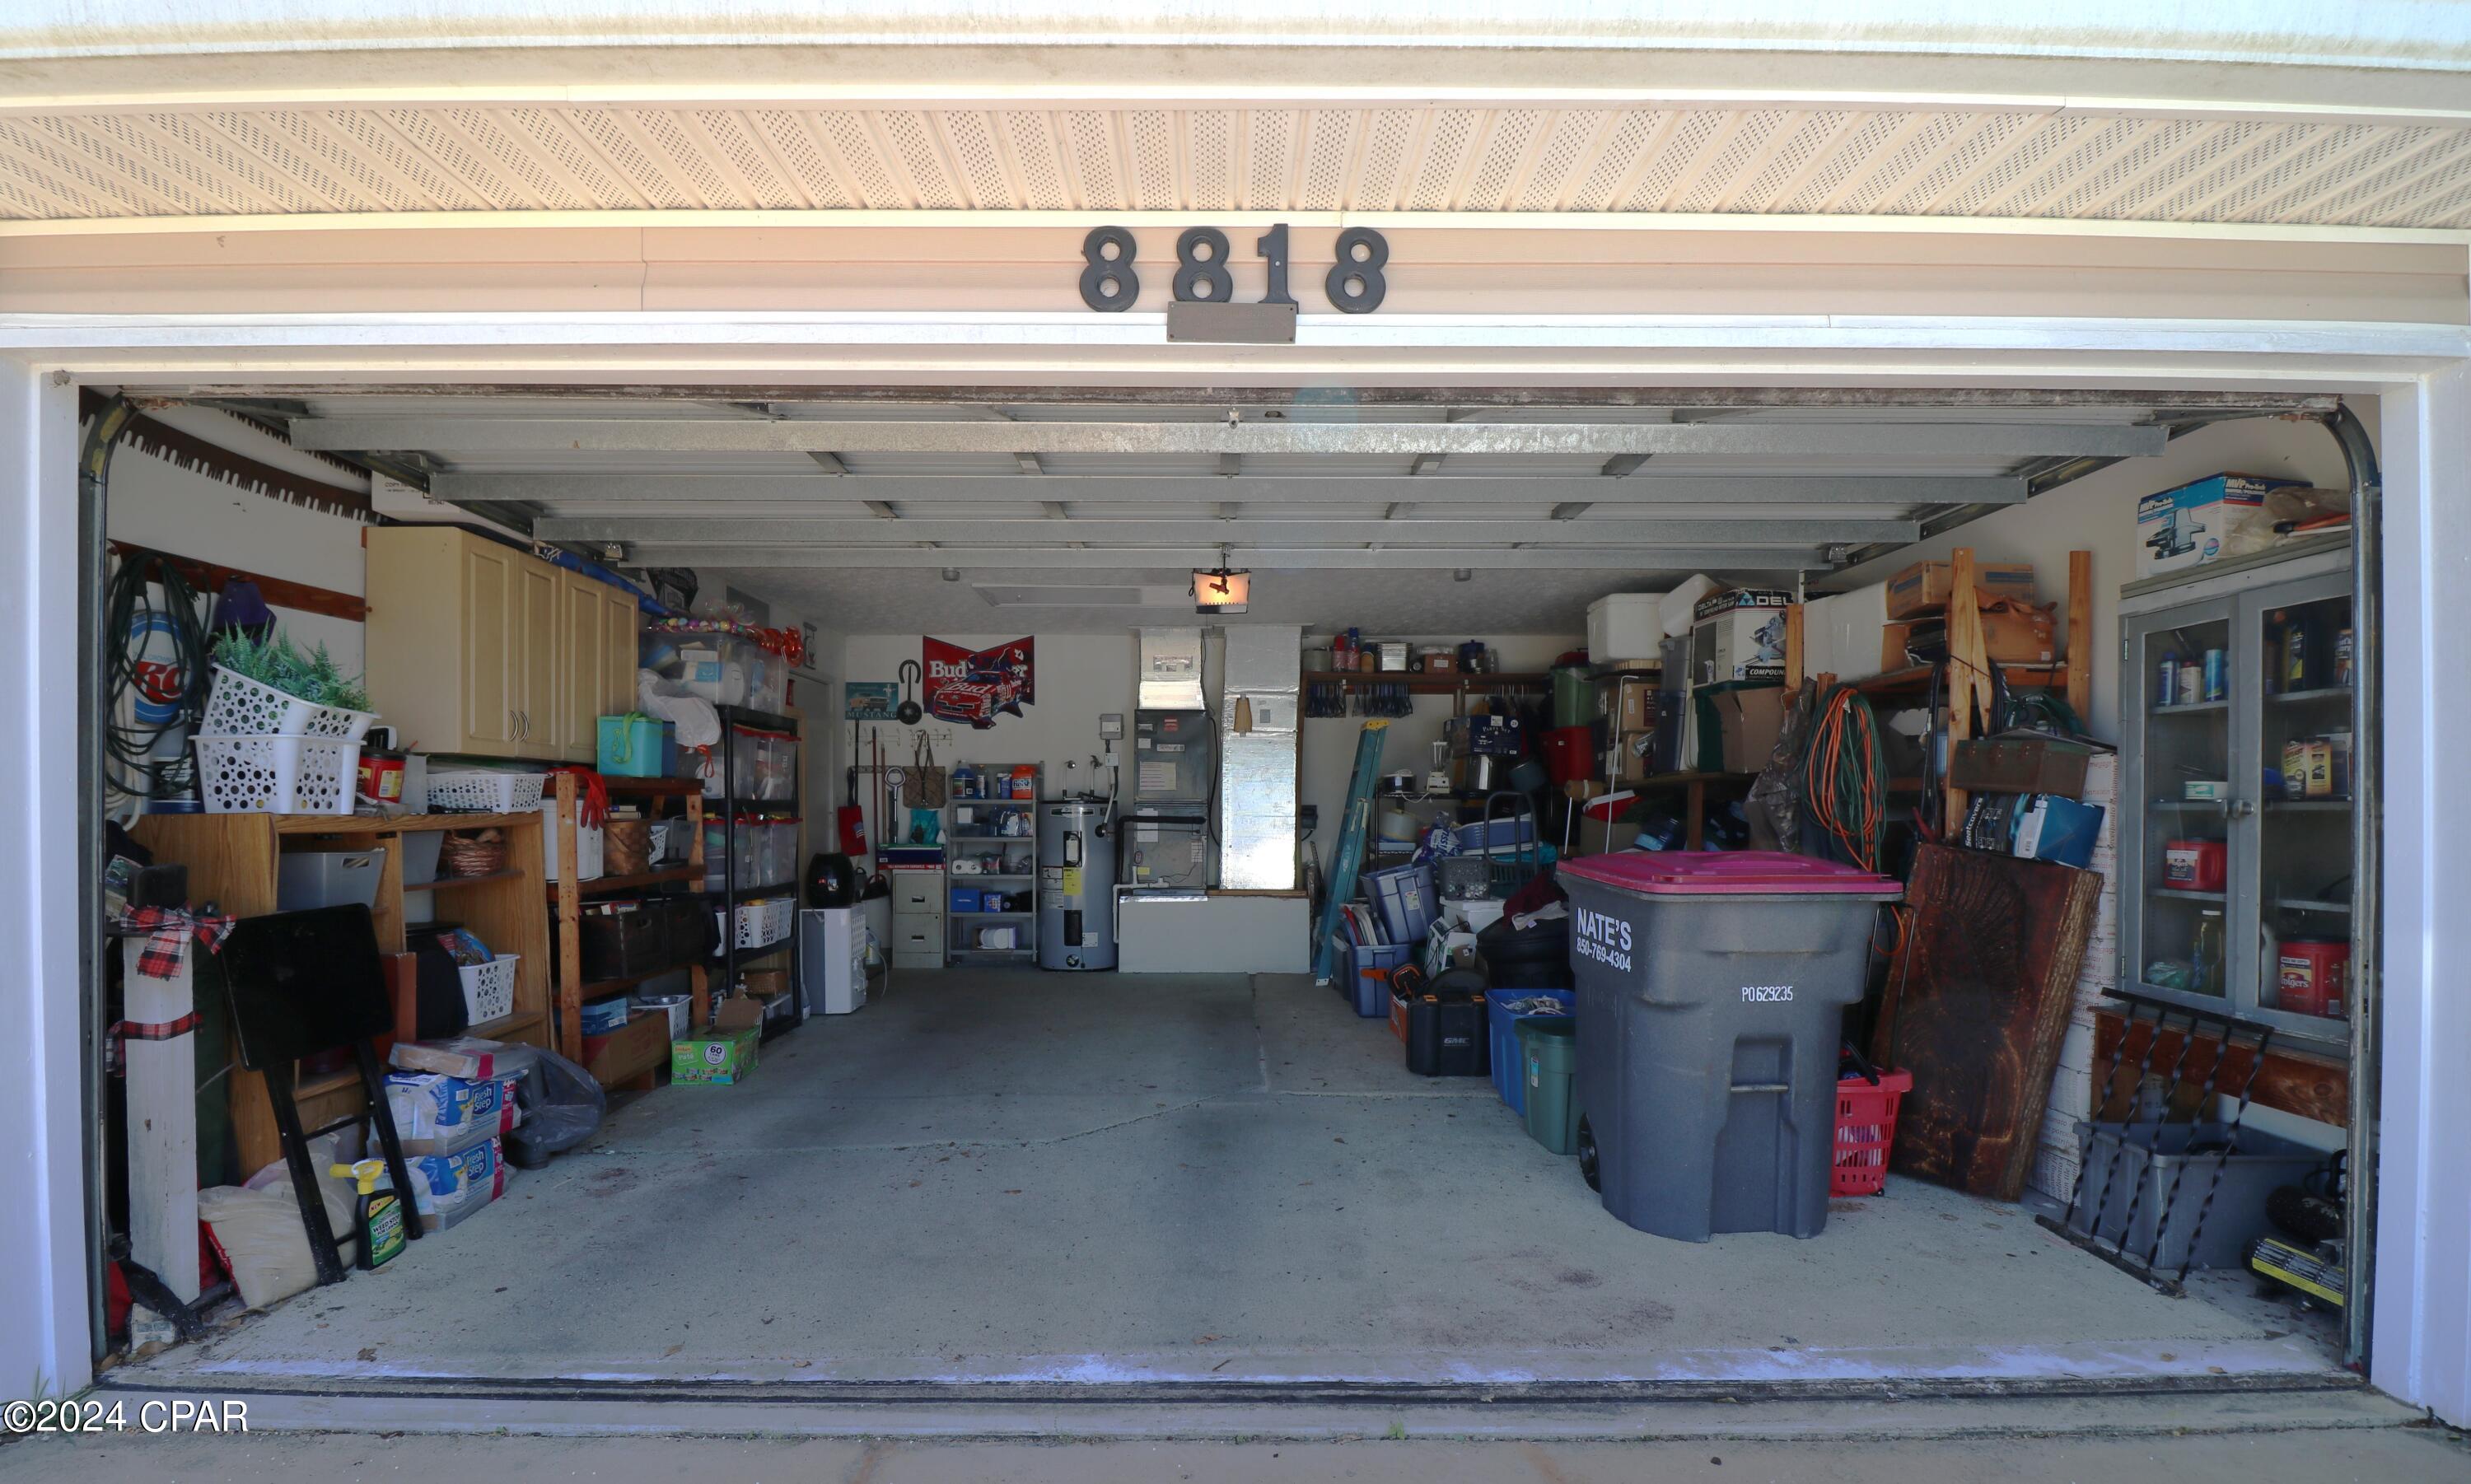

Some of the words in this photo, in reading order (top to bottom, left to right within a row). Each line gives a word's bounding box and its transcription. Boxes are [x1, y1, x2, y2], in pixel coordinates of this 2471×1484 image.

[929, 660, 968, 679] Bud
[944, 683, 993, 694] Bud
[1964, 797, 1983, 847] Seatcovers
[1576, 907, 1633, 950] NATE'S
[1576, 936, 1632, 973] 850-769-4304
[710, 1046, 722, 1054] 60
[474, 1086, 493, 1103] Fresh
[474, 1098, 492, 1112] Step
[466, 1150, 484, 1164] Fresh
[468, 1161, 484, 1177] Step
[370, 1202, 382, 1211] NEW
[373, 1220, 390, 1233] WEED
[389, 1211, 401, 1225] STOP
